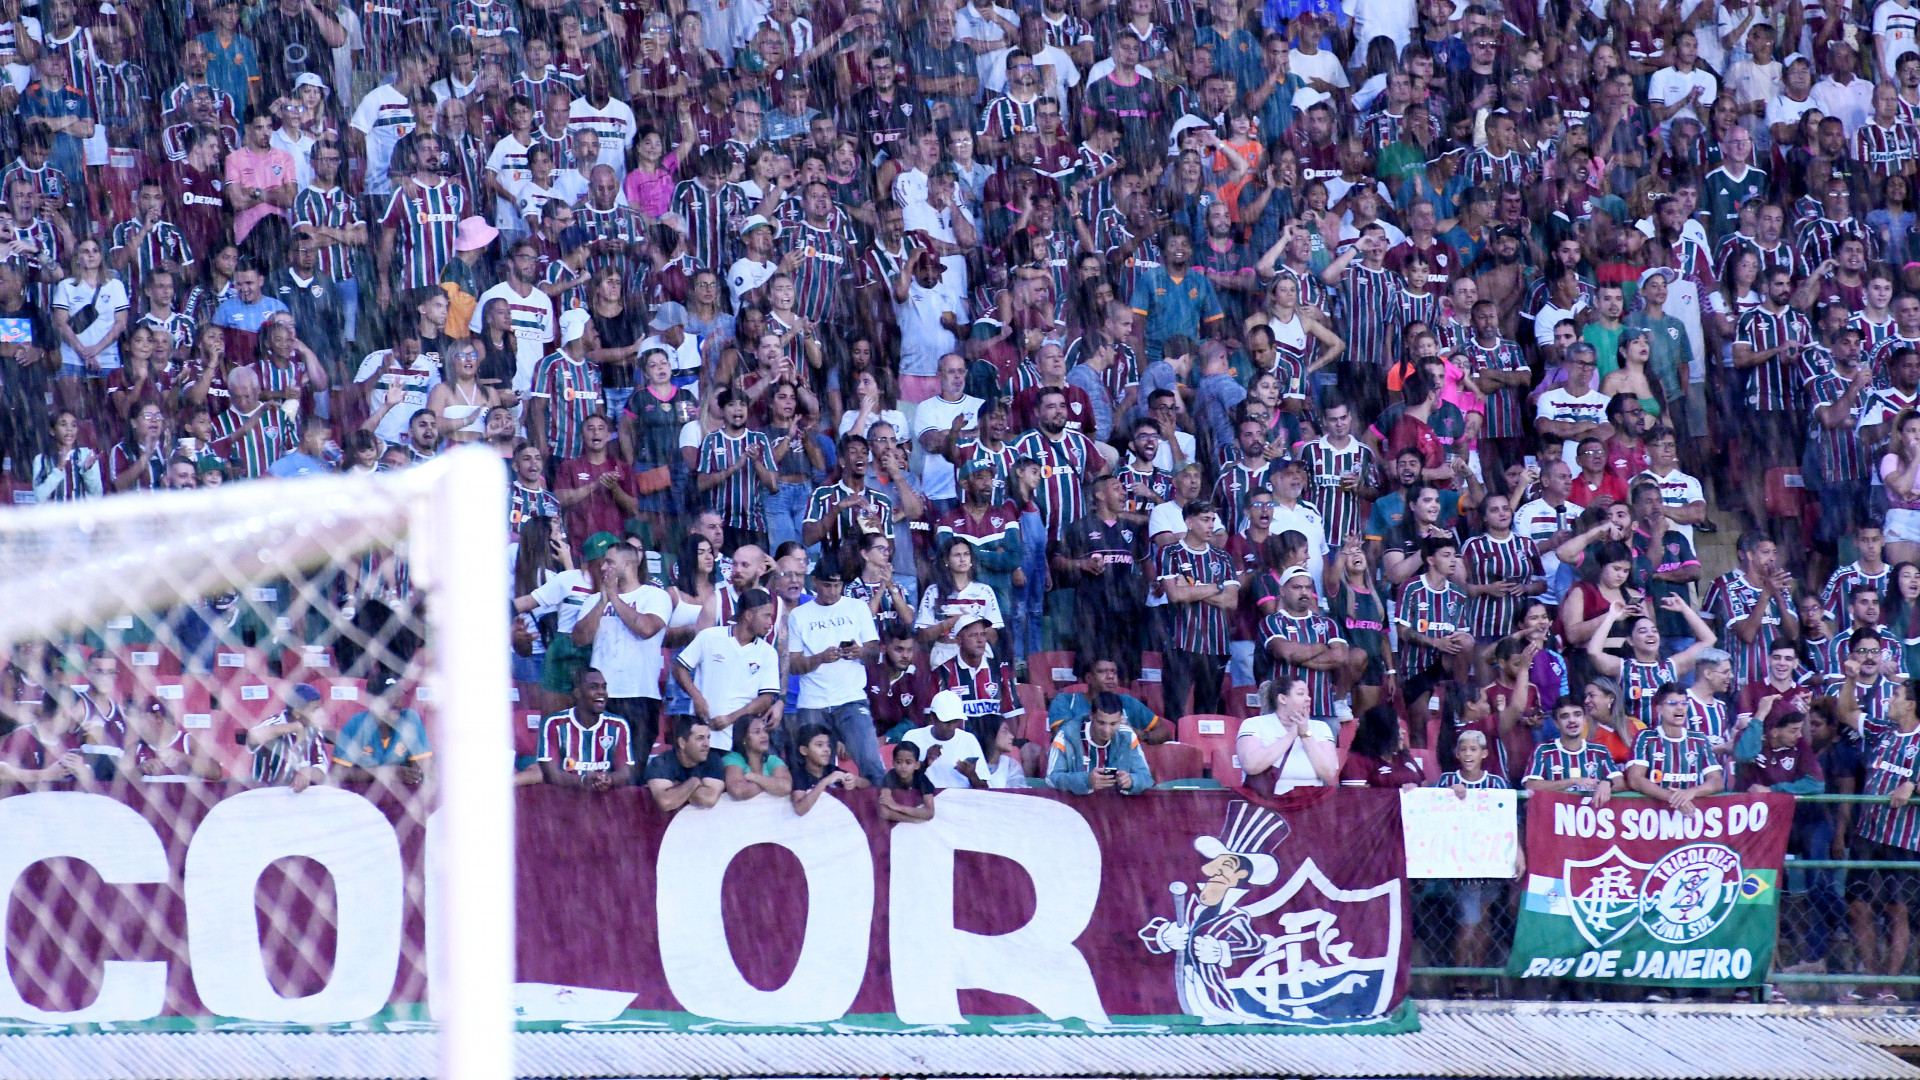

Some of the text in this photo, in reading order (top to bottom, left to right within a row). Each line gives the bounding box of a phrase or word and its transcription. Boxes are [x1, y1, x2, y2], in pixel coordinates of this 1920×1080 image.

[427, 213, 458, 222] BETANO
[815, 251, 845, 266] BETANO
[810, 616, 854, 631] PRADA
[575, 761, 611, 772] BETANO
[1880, 760, 1914, 778] BETANO
[1663, 773, 1699, 783] BETANO
[1554, 797, 1769, 841] NÓS SOMOS DO
[1653, 848, 1737, 882] TRICOLORES
[1650, 915, 1716, 940] ZONA SUL
[1520, 947, 1753, 980] RIO DE JANEIRO
